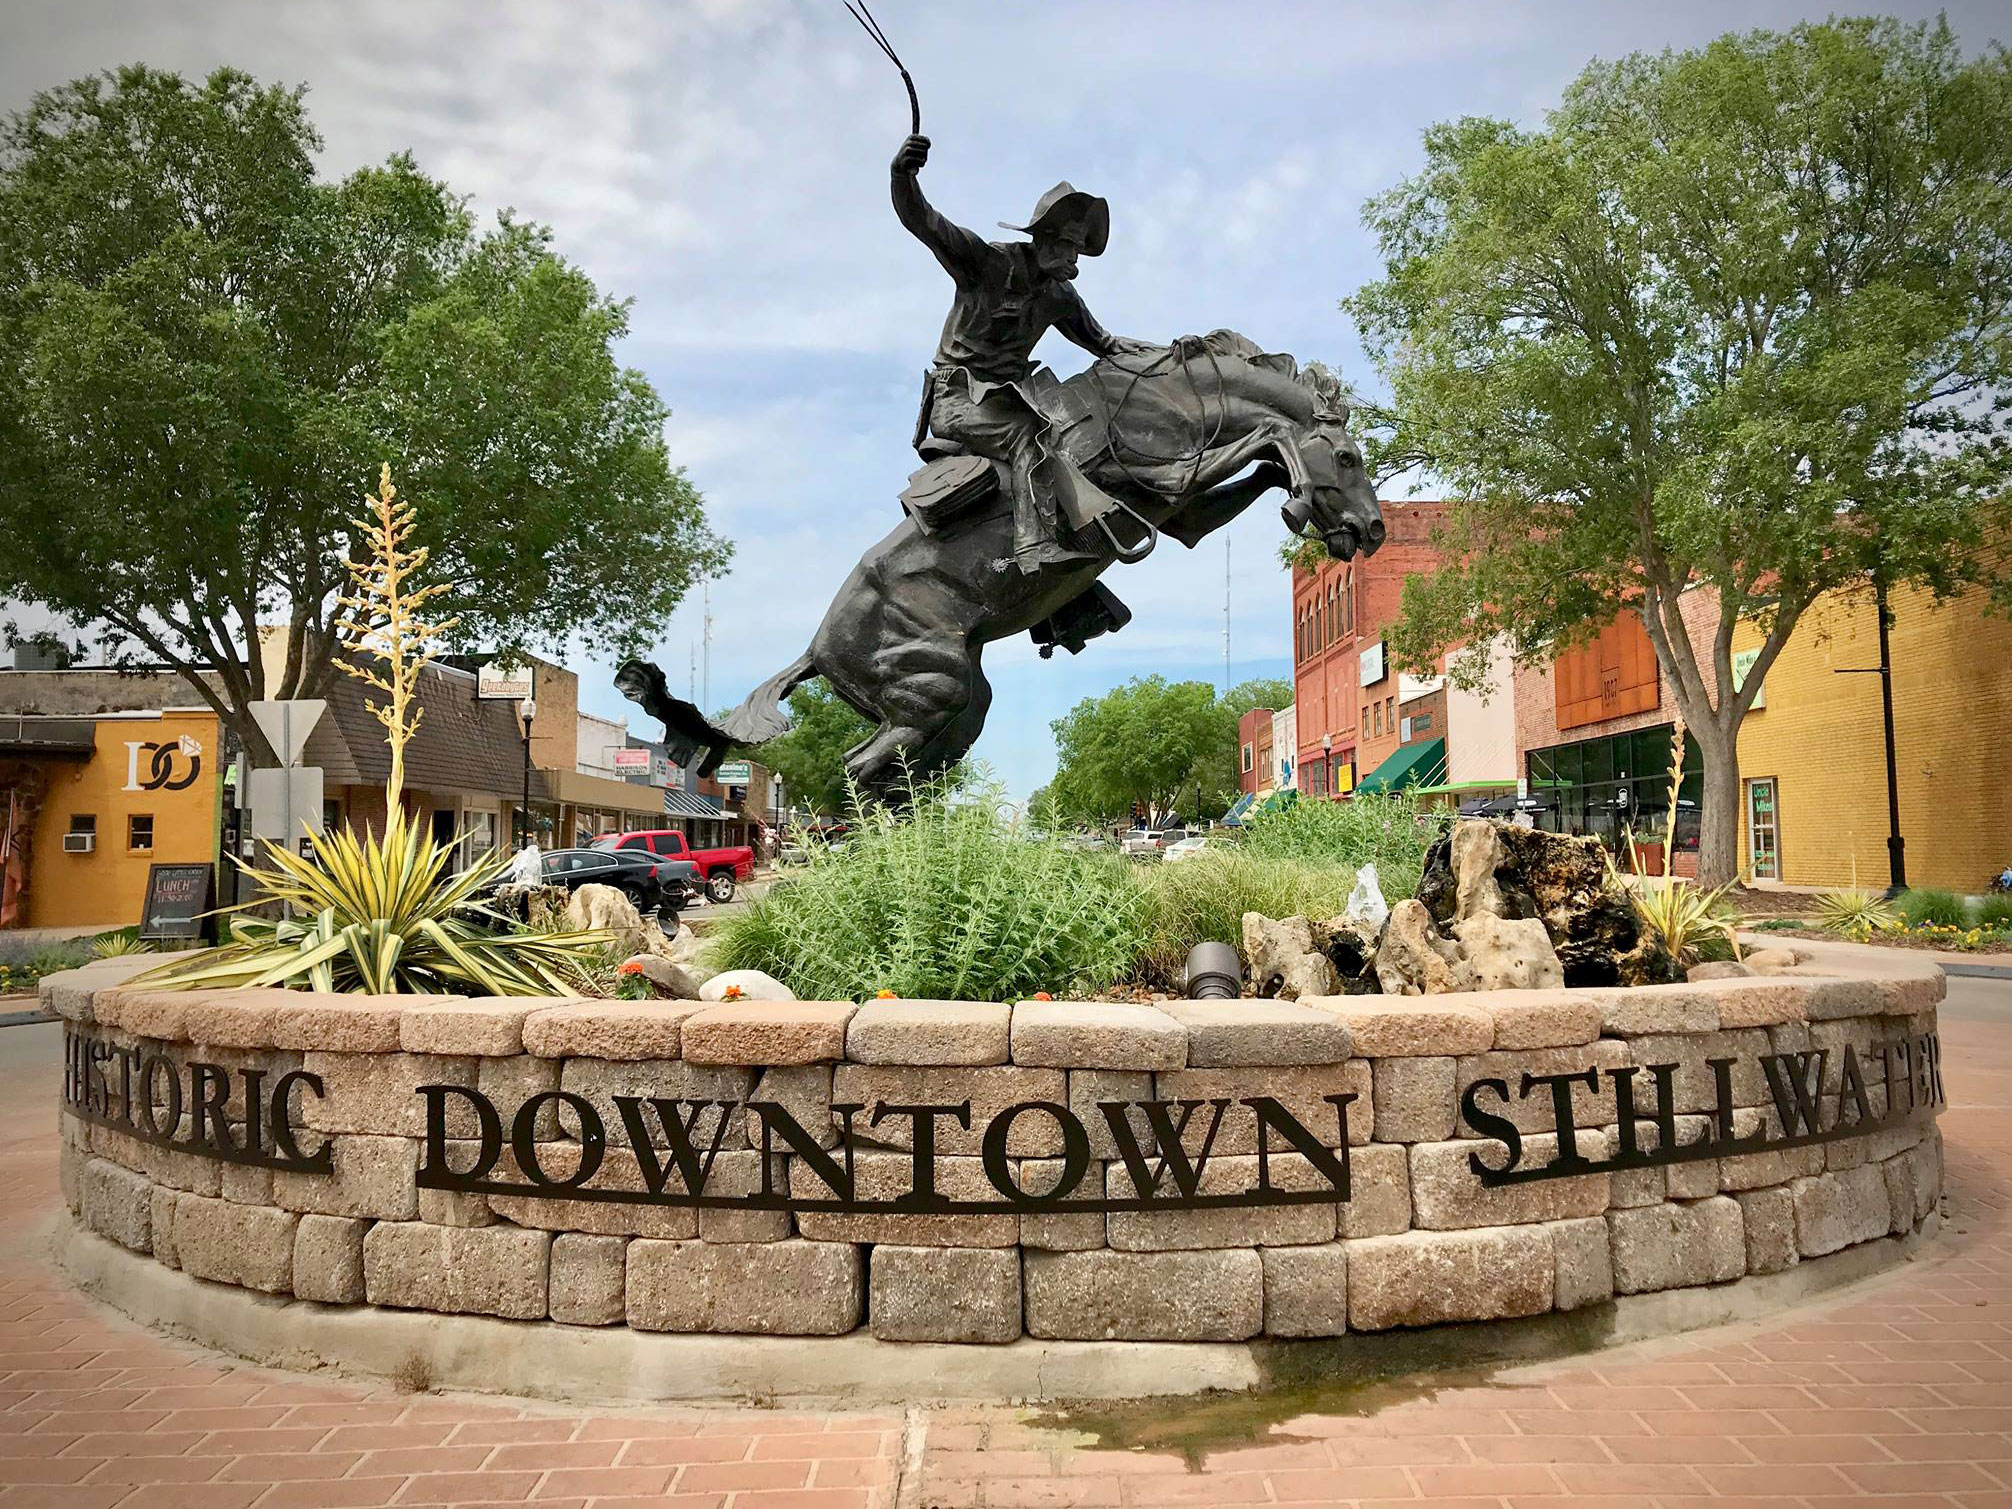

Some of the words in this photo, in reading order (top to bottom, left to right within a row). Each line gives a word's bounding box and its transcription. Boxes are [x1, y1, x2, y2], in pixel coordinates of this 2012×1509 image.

[156, 879, 190, 892] LUNCH
[65, 1031, 334, 1174] HISTORIC
[415, 1085, 1358, 1209] DOWNTOWN
[1461, 1030, 1947, 1188] STILLWATER
